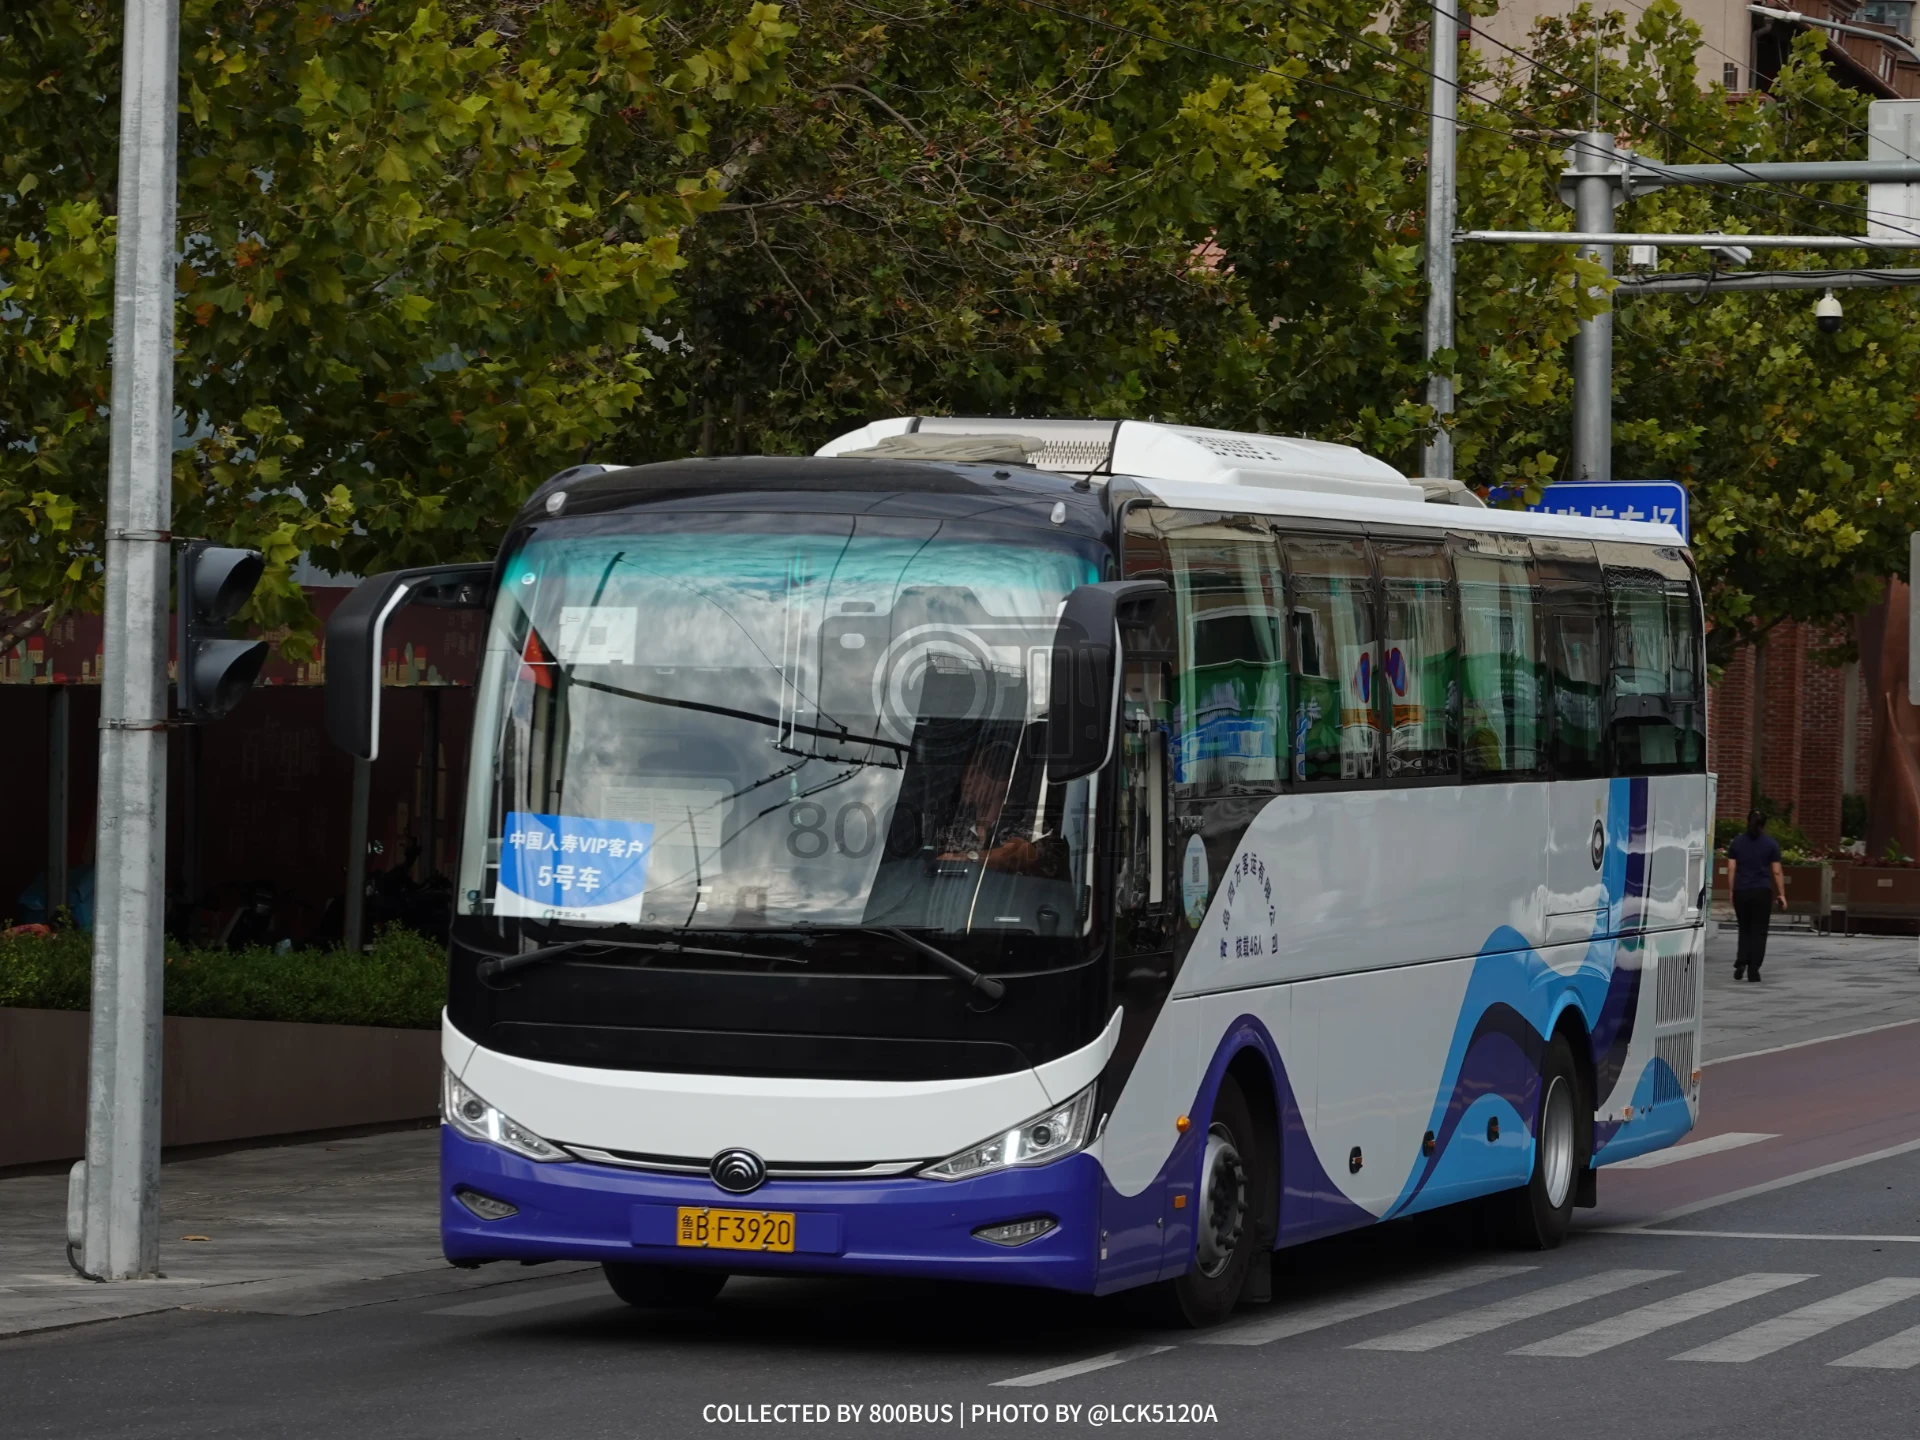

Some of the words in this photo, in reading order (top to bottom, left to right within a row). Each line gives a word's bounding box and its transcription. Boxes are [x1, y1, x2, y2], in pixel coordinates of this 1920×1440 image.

[509, 829, 644, 859] 中国人寿VIP客户
[536, 865, 602, 893] 5号车
